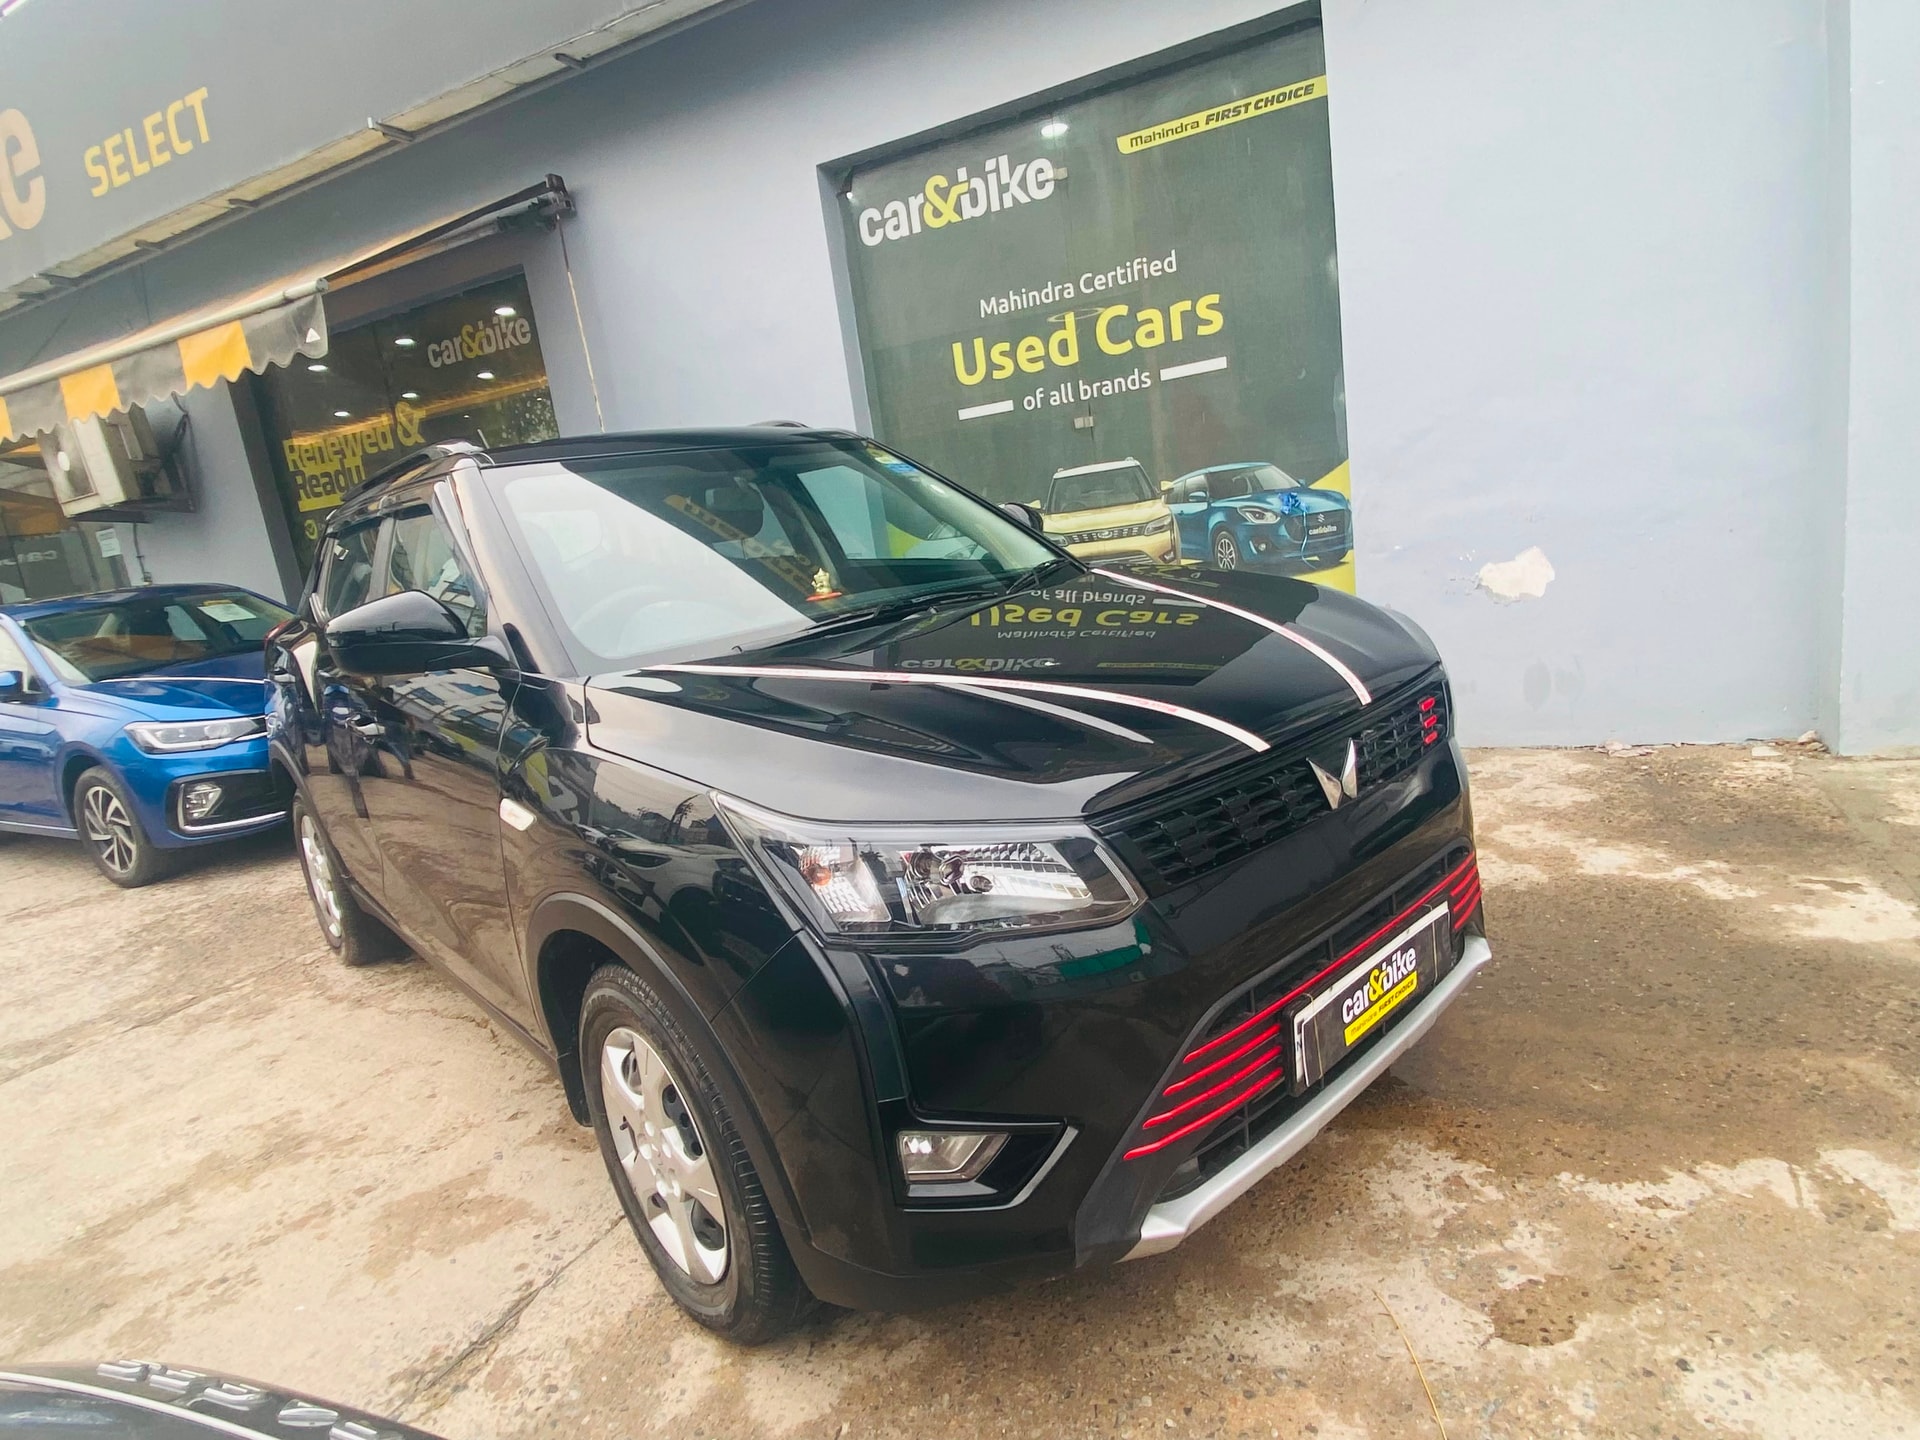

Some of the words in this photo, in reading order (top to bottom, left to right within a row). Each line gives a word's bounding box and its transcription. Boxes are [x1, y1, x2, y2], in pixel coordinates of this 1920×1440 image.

[84, 86, 210, 198] SELECT
[1129, 120, 1200, 148] Mahindra
[1205, 102, 1252, 126] FIRST
[1253, 83, 1315, 111] CHOICE
[859, 154, 1055, 247] car&bike
[979, 281, 1075, 318] Mahindra
[1079, 249, 1178, 294] Certified
[427, 316, 532, 369] car&bike
[952, 311, 1080, 386] Used
[1095, 293, 1225, 356] Cars
[1023, 387, 1045, 411] of
[1049, 382, 1075, 406] all
[1078, 367, 1152, 401] brands
[282, 413, 395, 472] Renewed
[1342, 947, 1417, 1024] car&bike
